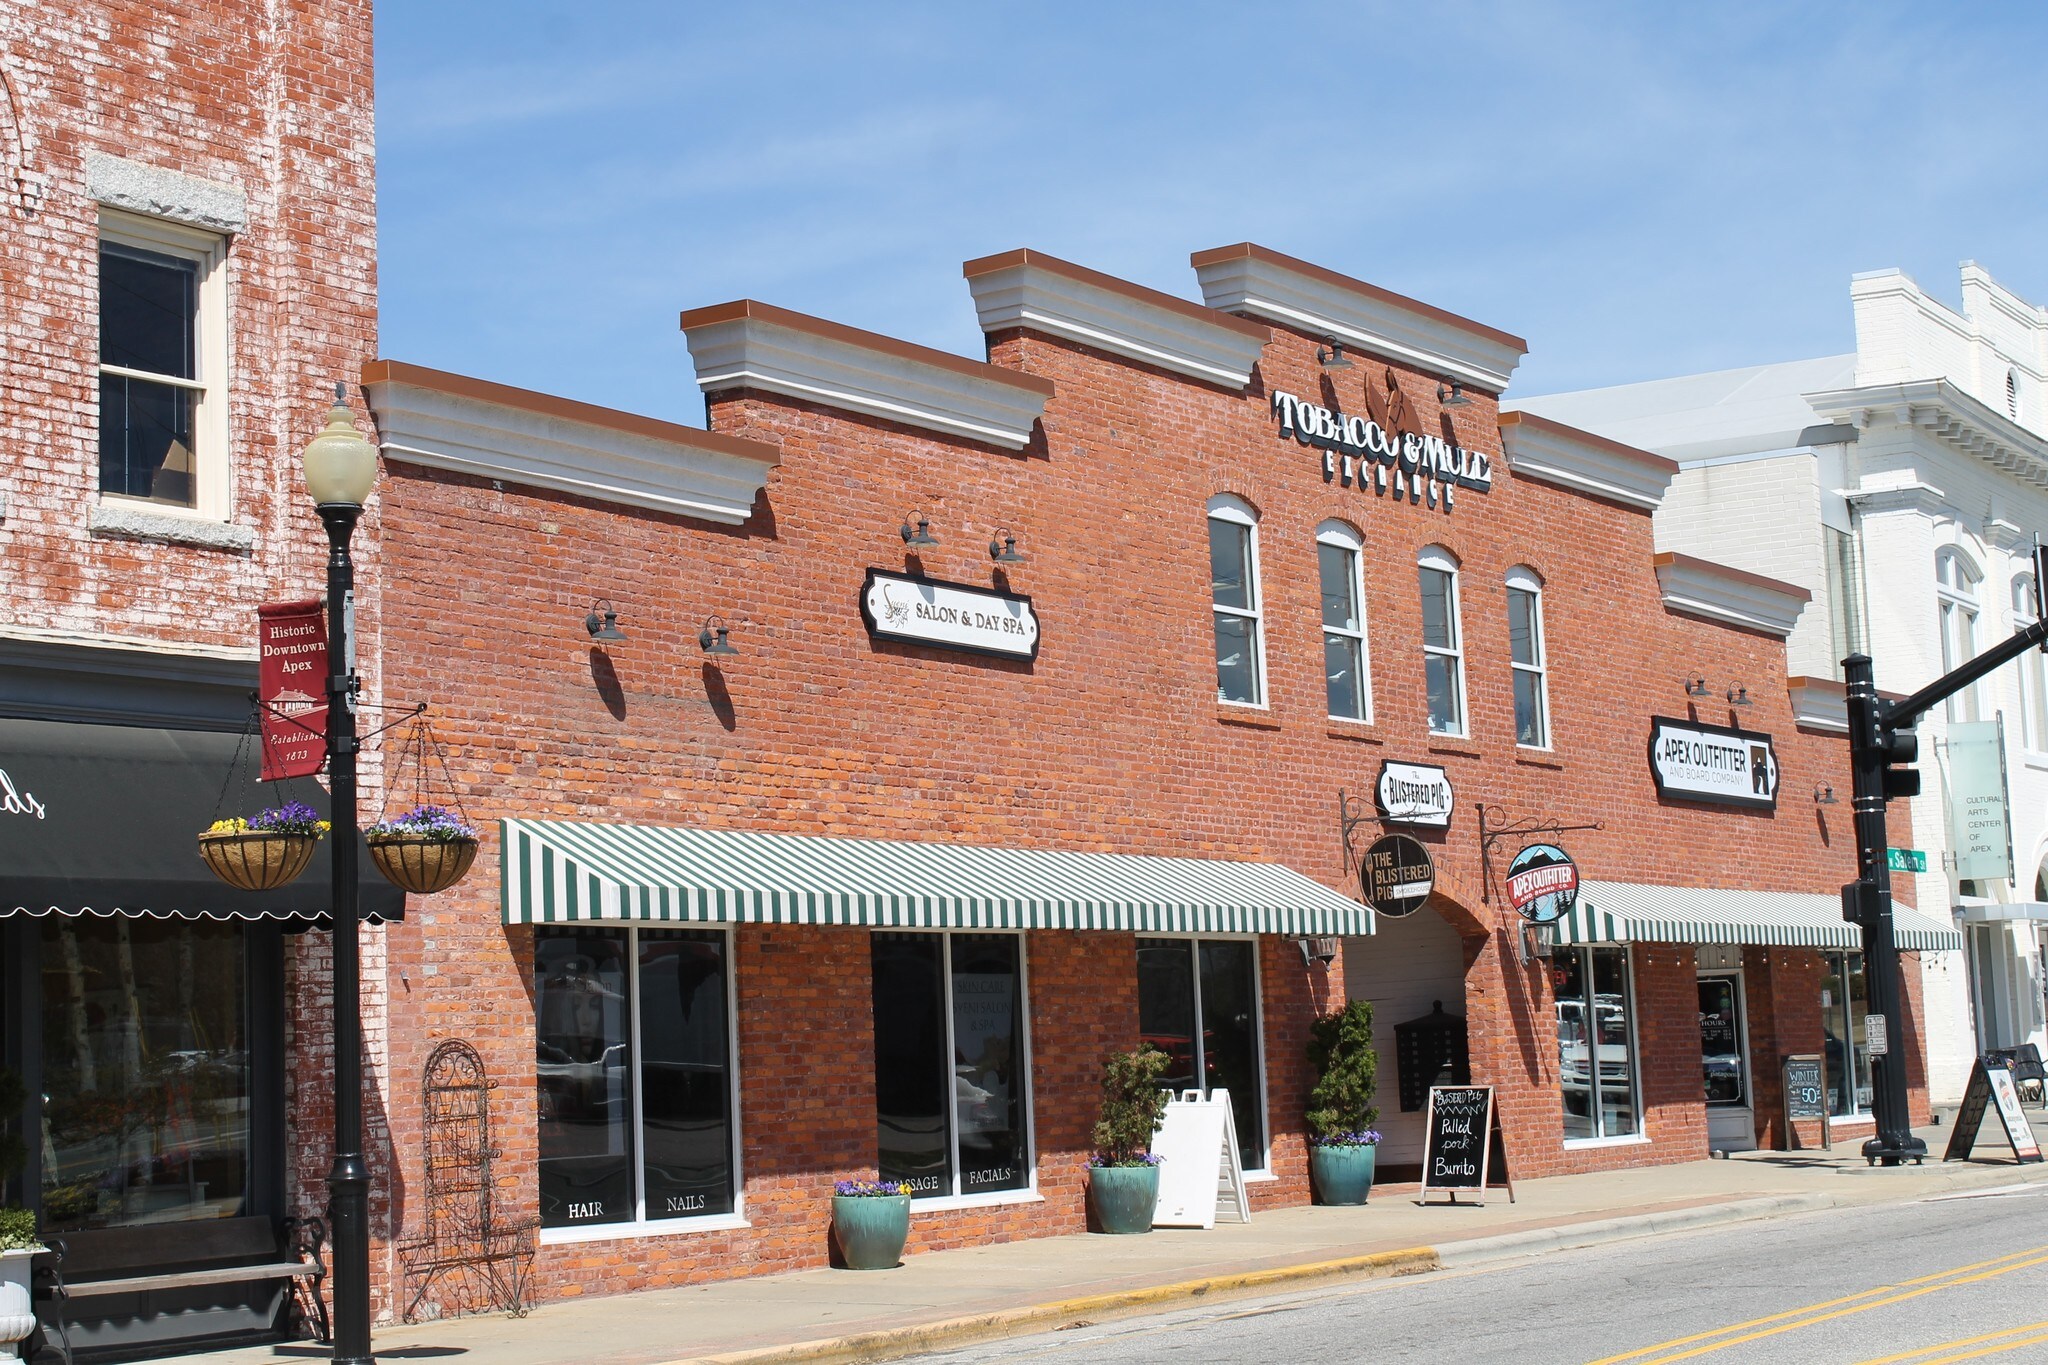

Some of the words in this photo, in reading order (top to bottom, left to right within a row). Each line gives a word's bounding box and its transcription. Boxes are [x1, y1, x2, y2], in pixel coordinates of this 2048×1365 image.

[1275, 390, 1399, 456] TOBACCO
[1403, 432, 1424, 463] &
[1422, 434, 1491, 483] MULE
[1325, 450, 1455, 506] EXCHANGE
[916, 603, 957, 625] SALON
[961, 611, 973, 627] &
[975, 613, 1001, 631] DAY
[1002, 618, 1026, 636] SPA
[270, 623, 316, 639] Historic
[263, 641, 326, 657] Downtown
[281, 660, 313, 674] Apex
[270, 729, 326, 745] Established
[285, 750, 308, 762] 1873
[1664, 738, 1692, 765] APEX
[1693, 742, 1747, 773] OUTFITTER
[1669, 766, 1685, 779] AND
[1686, 768, 1710, 782] BOARD
[1711, 771, 1744, 787] COMPANY
[1388, 776, 1430, 805] BLISTERED
[1431, 782, 1445, 810] PIG
[1966, 796, 2003, 804] CULTURAL
[1967, 808, 1989, 816] ARTS
[1968, 820, 2001, 829] CENTER
[1968, 833, 1981, 841] OF
[1970, 844, 1992, 853] APEX
[1372, 852, 1393, 868] THE
[1894, 851, 1918, 869] Salem
[1375, 864, 1431, 884] BLISTERED
[1513, 873, 1534, 899] APEX
[1532, 866, 1572, 888] OUTFITTER
[1376, 886, 1394, 901] PIG
[1520, 893, 1533, 903] AND
[1534, 886, 1555, 896] BOARD
[957, 979, 979, 992] SKIN
[980, 978, 1005, 992] CARE
[978, 1018, 997, 1031] SPA
[1789, 1069, 1819, 1081] WINTER
[1801, 1087, 1817, 1104] 50
[1441, 1117, 1472, 1135] Pulled
[1441, 1135, 1470, 1155] pork
[1435, 1157, 1476, 1176] Burrito
[969, 1167, 1011, 1184] FACIALS
[568, 1201, 604, 1219] HAIR
[666, 1194, 705, 1212] NAILS
